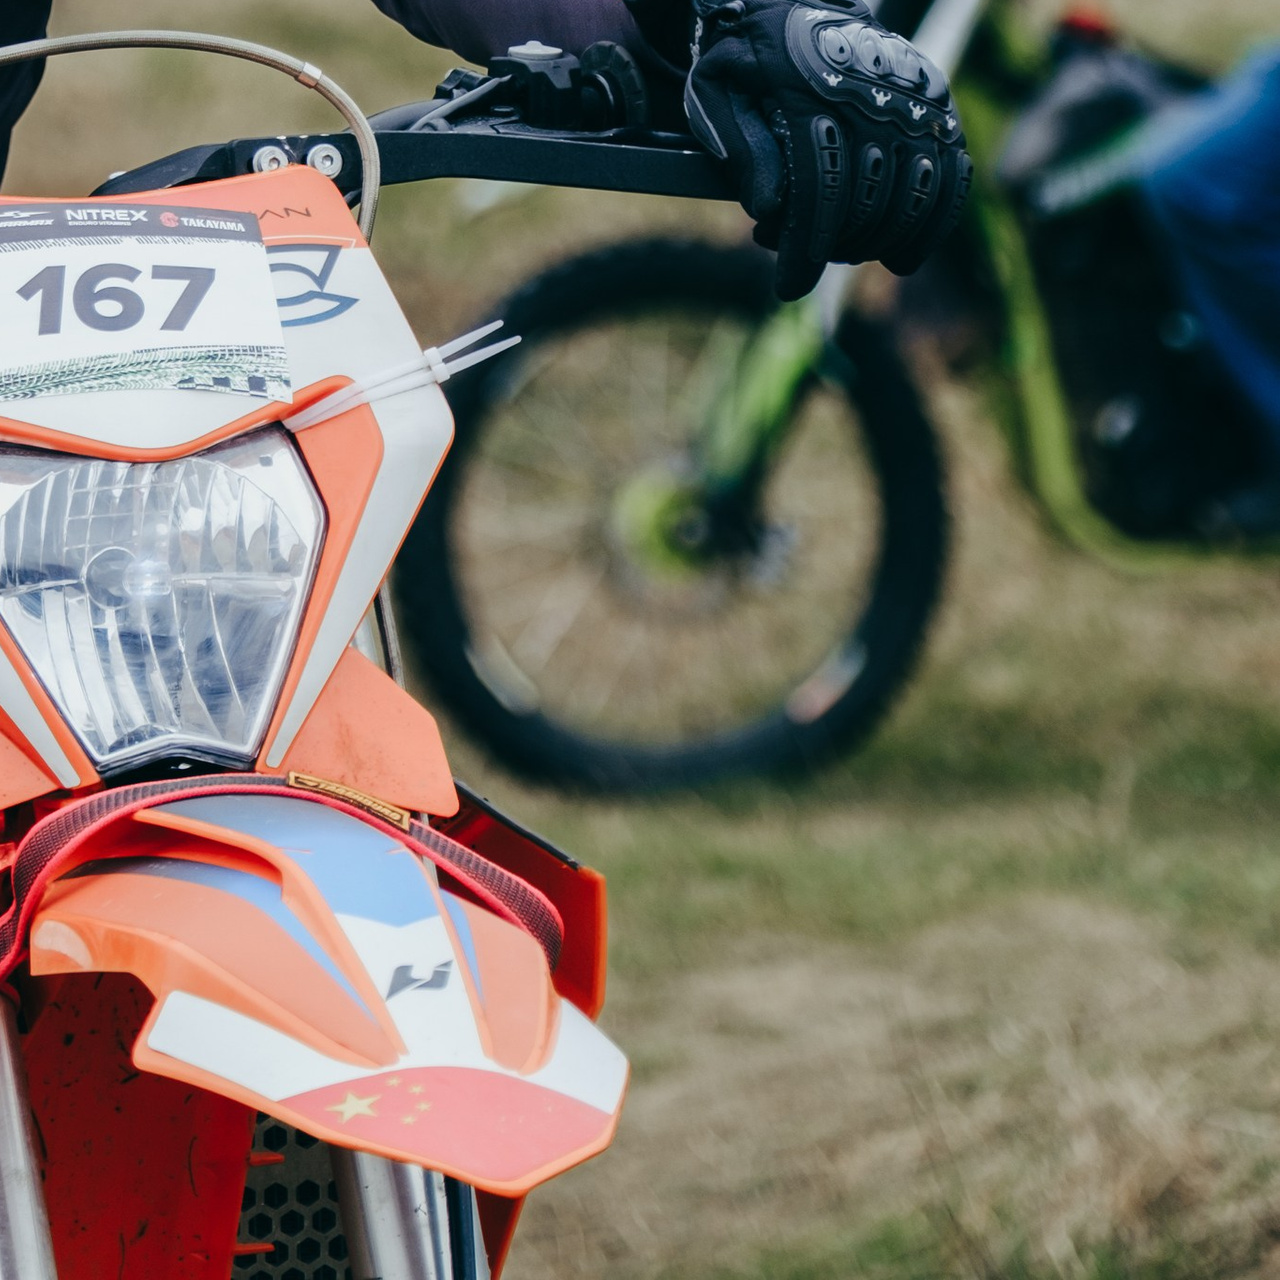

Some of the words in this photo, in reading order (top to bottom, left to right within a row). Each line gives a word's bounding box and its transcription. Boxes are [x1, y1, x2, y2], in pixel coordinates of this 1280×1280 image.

[65, 209, 148, 222] NITREX
[180, 217, 246, 232] TAKAYAMA
[16, 263, 216, 336] 167
